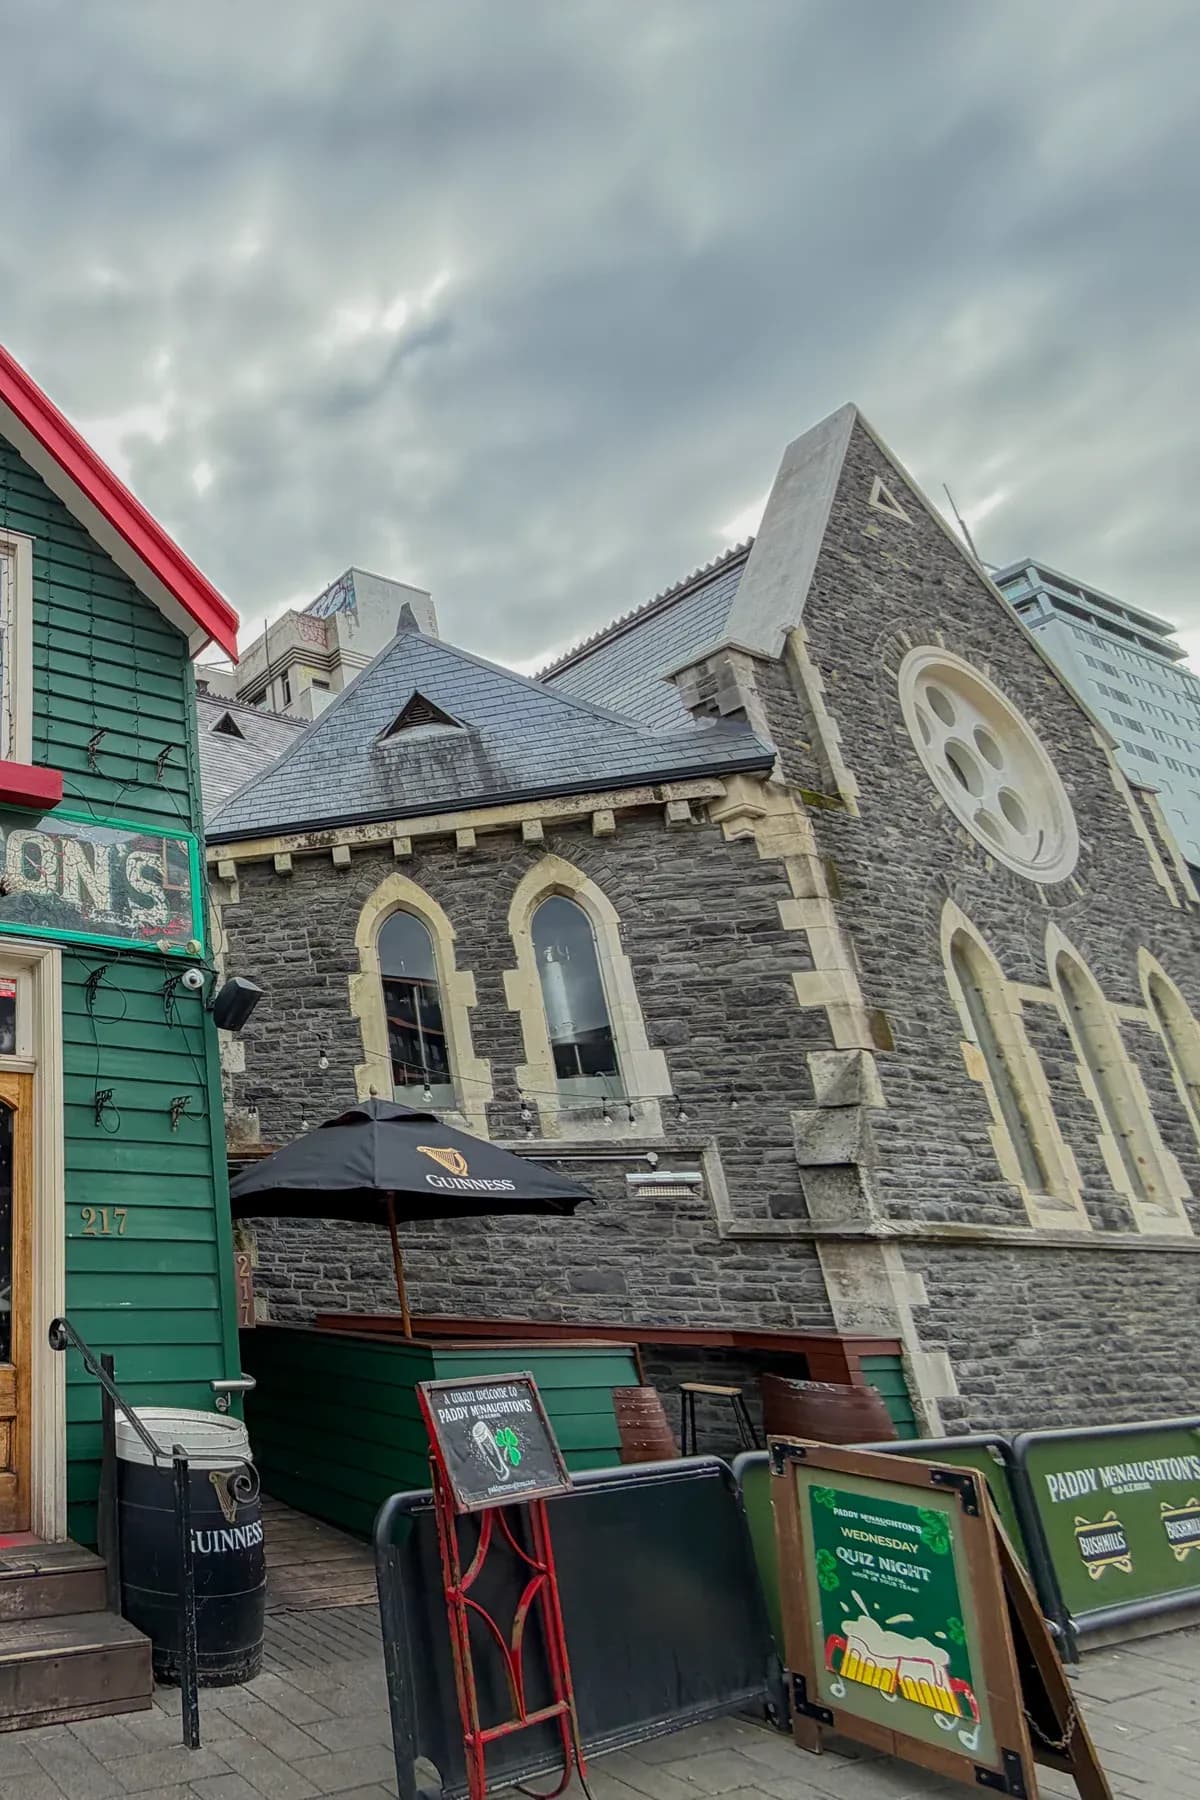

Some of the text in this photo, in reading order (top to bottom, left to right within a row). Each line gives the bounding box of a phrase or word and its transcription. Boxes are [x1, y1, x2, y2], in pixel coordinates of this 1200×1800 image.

[425, 1174, 516, 1191] GUINNESS
[81, 1206, 128, 1236] 217
[237, 1255, 250, 1327] 217
[438, 1405, 469, 1424] PADDY
[1044, 1467, 1099, 1503] PADDY
[833, 1507, 859, 1518] PADDY
[840, 1526, 919, 1554] WEDNESDAY
[1078, 1532, 1126, 1556] BUSHMILLS
[835, 1546, 876, 1567] QUIZ
[878, 1556, 932, 1582] NIGHT
